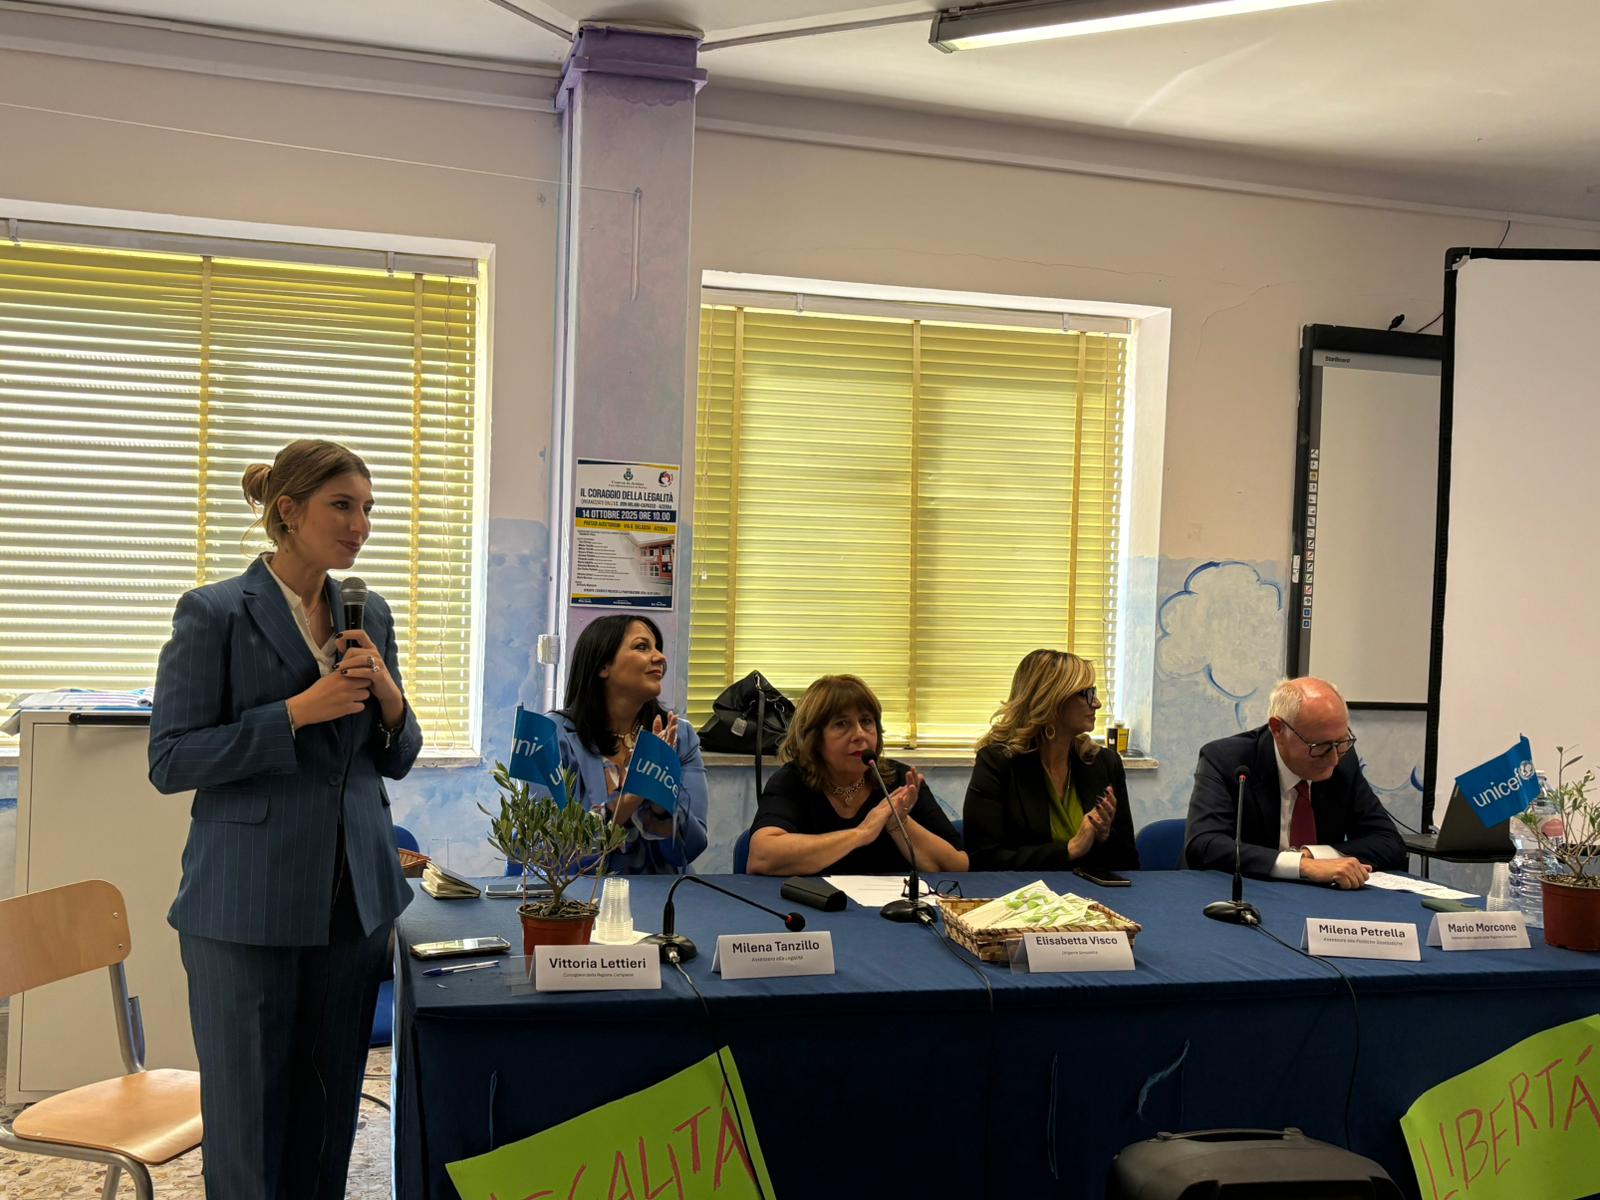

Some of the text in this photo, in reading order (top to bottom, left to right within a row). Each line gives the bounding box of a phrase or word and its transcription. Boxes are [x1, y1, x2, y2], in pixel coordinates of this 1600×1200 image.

[580, 488, 674, 502] IL CORAGGIO DELLA LEGALITÀ
[582, 509, 671, 521] 14 OTTOBRE 2025 ORE 10.00
[1472, 767, 1523, 807] unicef
[1318, 924, 1406, 938] Milena Petrella
[1447, 923, 1517, 933] Mario Morcone
[732, 940, 820, 954] Milena Tanzillo
[1036, 936, 1118, 946] Elisabetta Visco
[548, 957, 647, 970] Vittoria Lettieri
